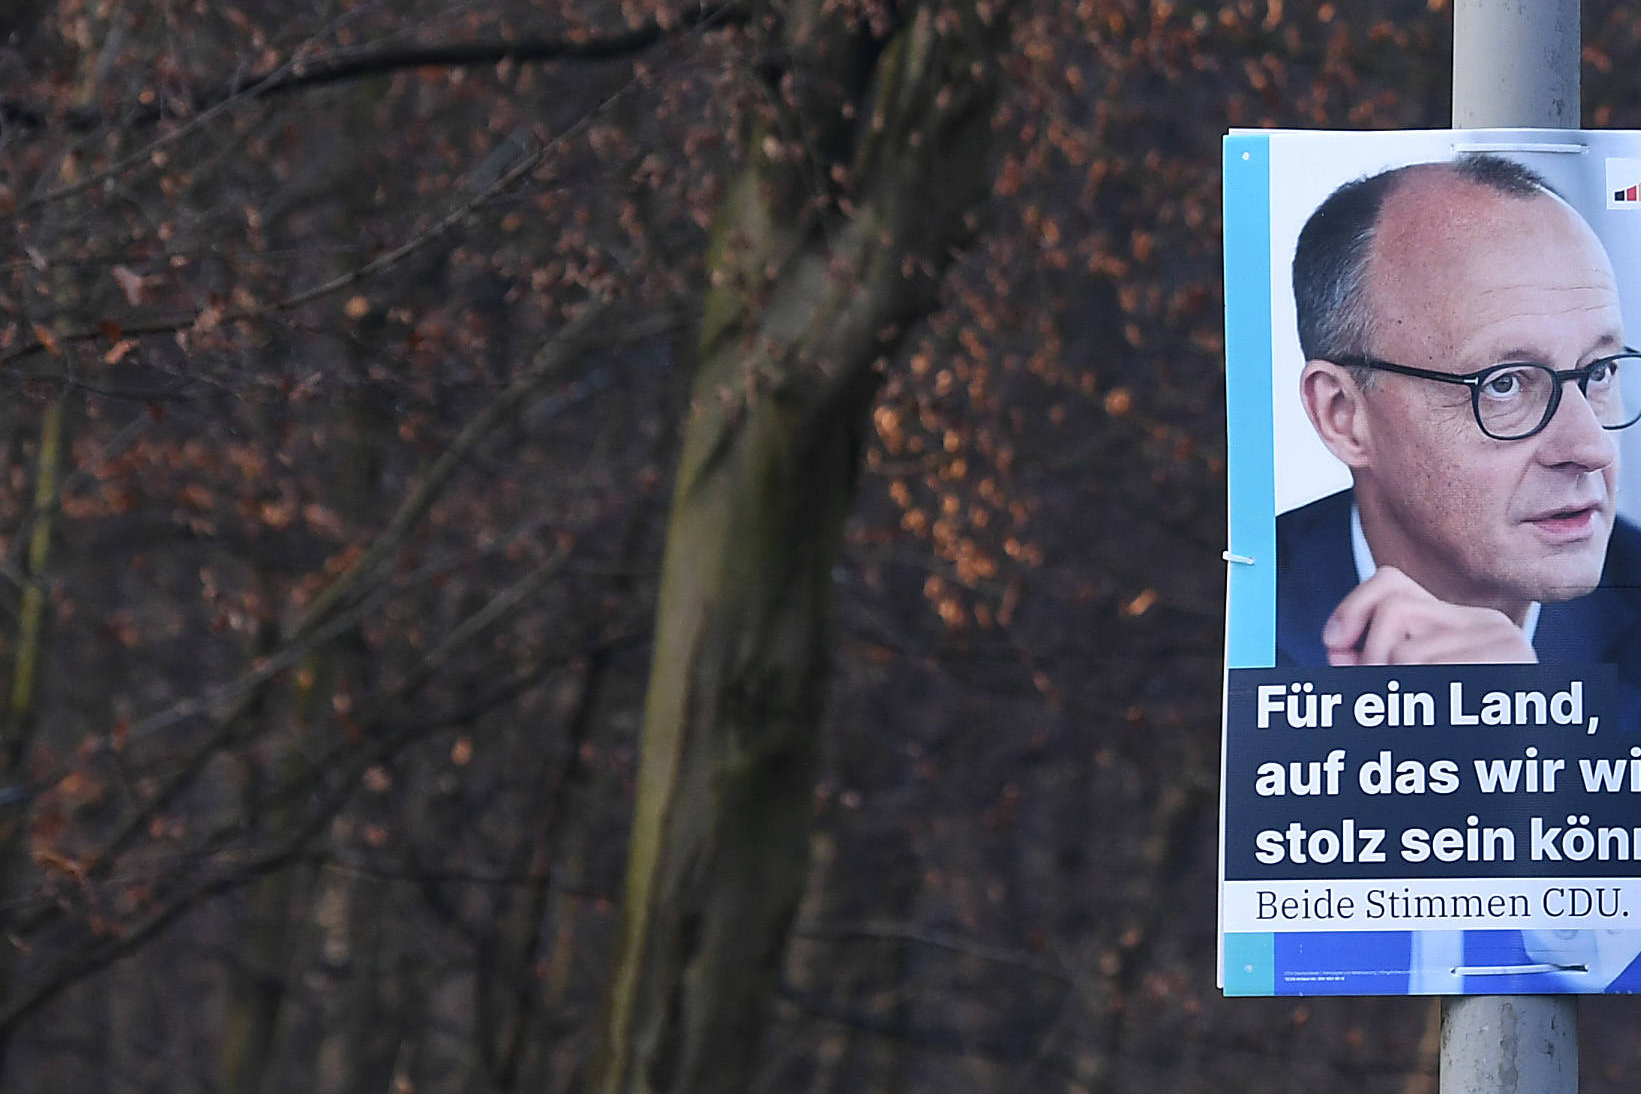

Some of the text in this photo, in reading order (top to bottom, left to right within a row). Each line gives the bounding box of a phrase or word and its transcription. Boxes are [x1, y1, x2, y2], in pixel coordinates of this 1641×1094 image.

[1256, 680, 1600, 735] Für ein Land,
[1254, 750, 1346, 797] auf
[1358, 750, 1461, 796] das
[1474, 747, 1566, 794] wir
[1254, 818, 1388, 864] stolz
[1400, 815, 1516, 863] sein
[1256, 886, 1631, 921] Beide Stimmen CDU.
